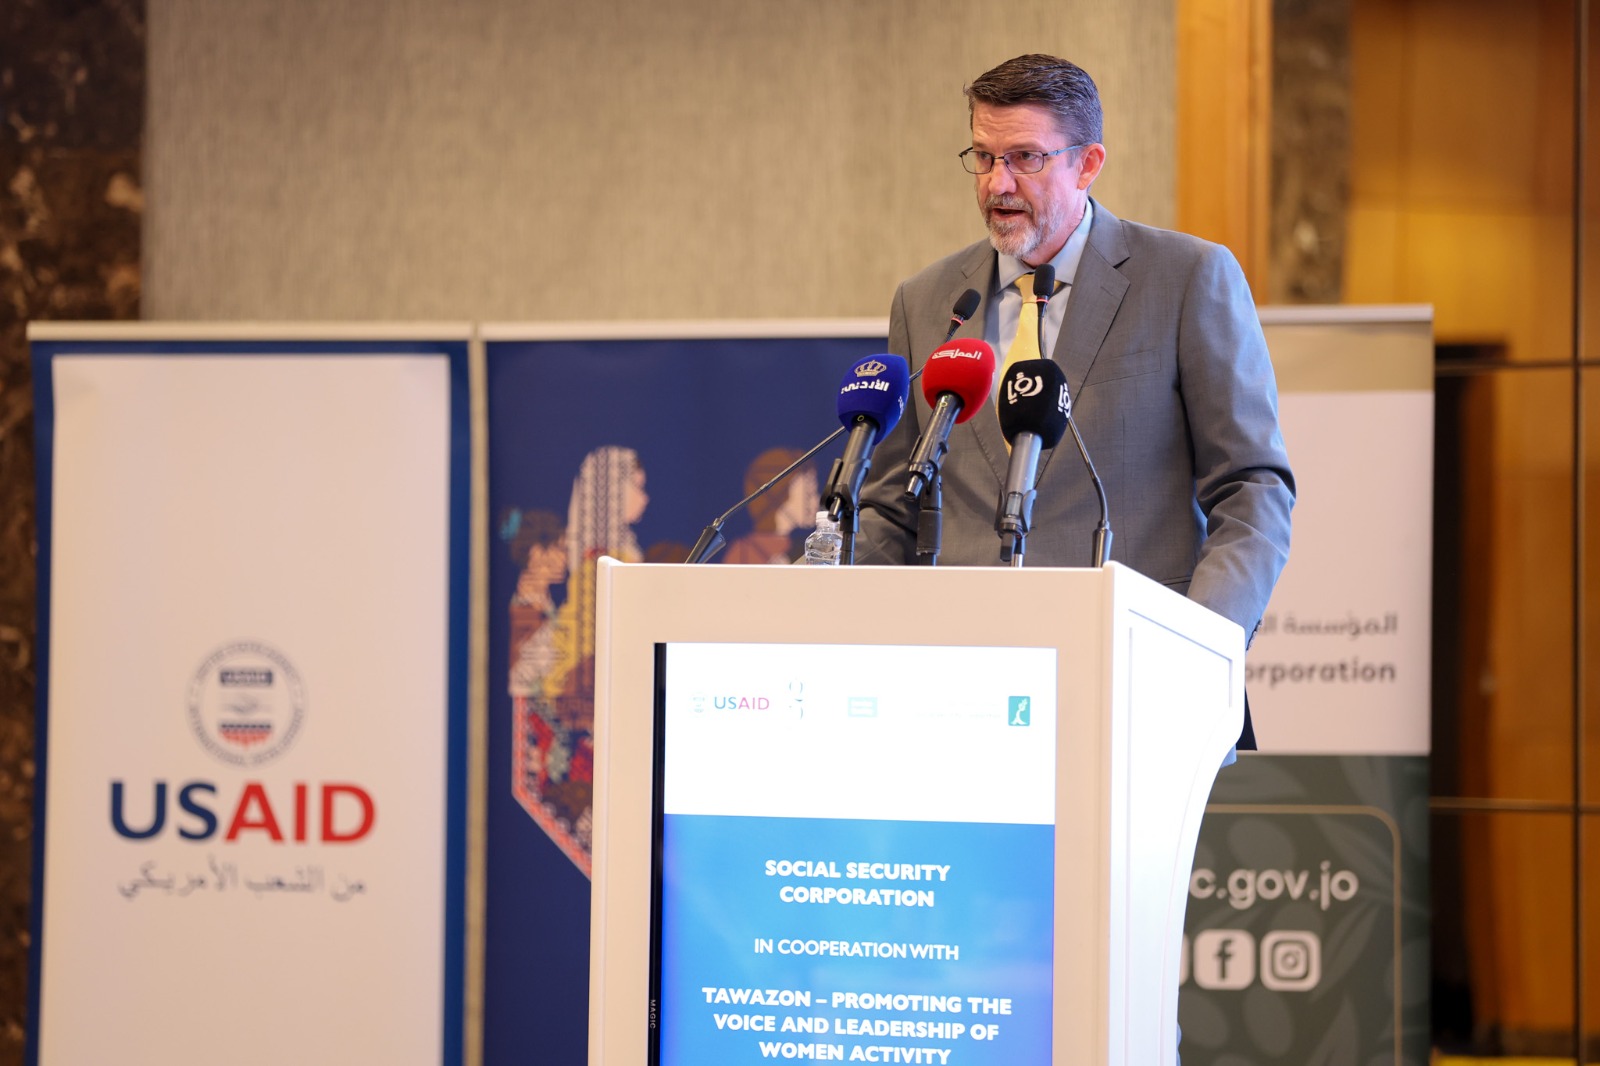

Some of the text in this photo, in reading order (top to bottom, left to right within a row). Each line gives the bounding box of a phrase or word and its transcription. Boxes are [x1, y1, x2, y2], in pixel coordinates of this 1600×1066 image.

[1244, 655, 1397, 691] orporation
[713, 696, 770, 711] USAID
[110, 780, 377, 844] USAID
[764, 859, 951, 882] SOCIAL SECURITY
[779, 885, 935, 908] CORPORATION
[1190, 860, 1358, 910] c.gov.jo
[754, 938, 959, 961] IN COOPERATION WITH
[701, 987, 811, 1007] TAWAZON
[831, 991, 962, 1013] PROMOTING
[967, 996, 1012, 1015] THE
[713, 1013, 999, 1041] VOICE AND LEADERSHIP OF
[758, 1041, 952, 1065] WOMEN ACTIVITY
